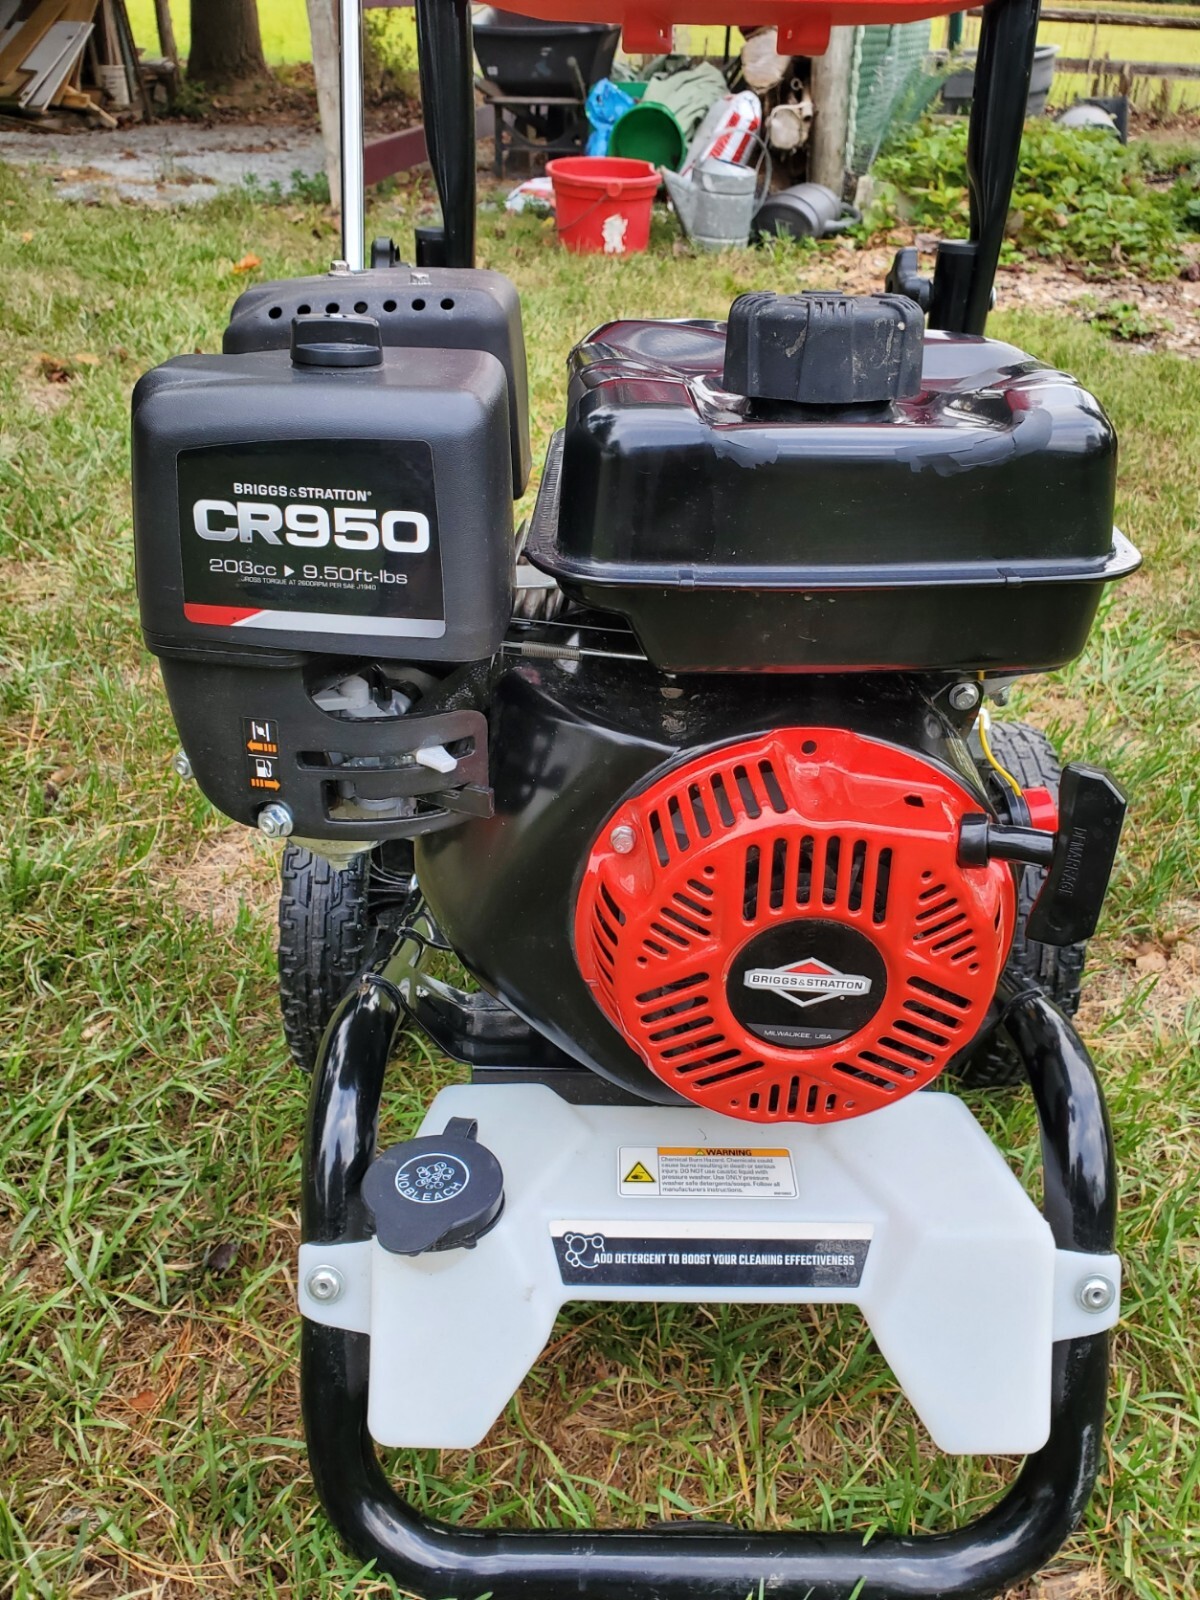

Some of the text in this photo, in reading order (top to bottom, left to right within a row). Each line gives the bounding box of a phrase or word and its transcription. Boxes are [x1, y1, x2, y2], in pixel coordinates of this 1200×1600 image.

[192, 499, 430, 553] CR950
[263, 577, 287, 585] TORQUE
[303, 565, 408, 584] 9.50ft-lbs
[593, 1252, 855, 1266] ADD DETERGENT TO BOOST YOUR CLEANING EFFECTIVENESS
